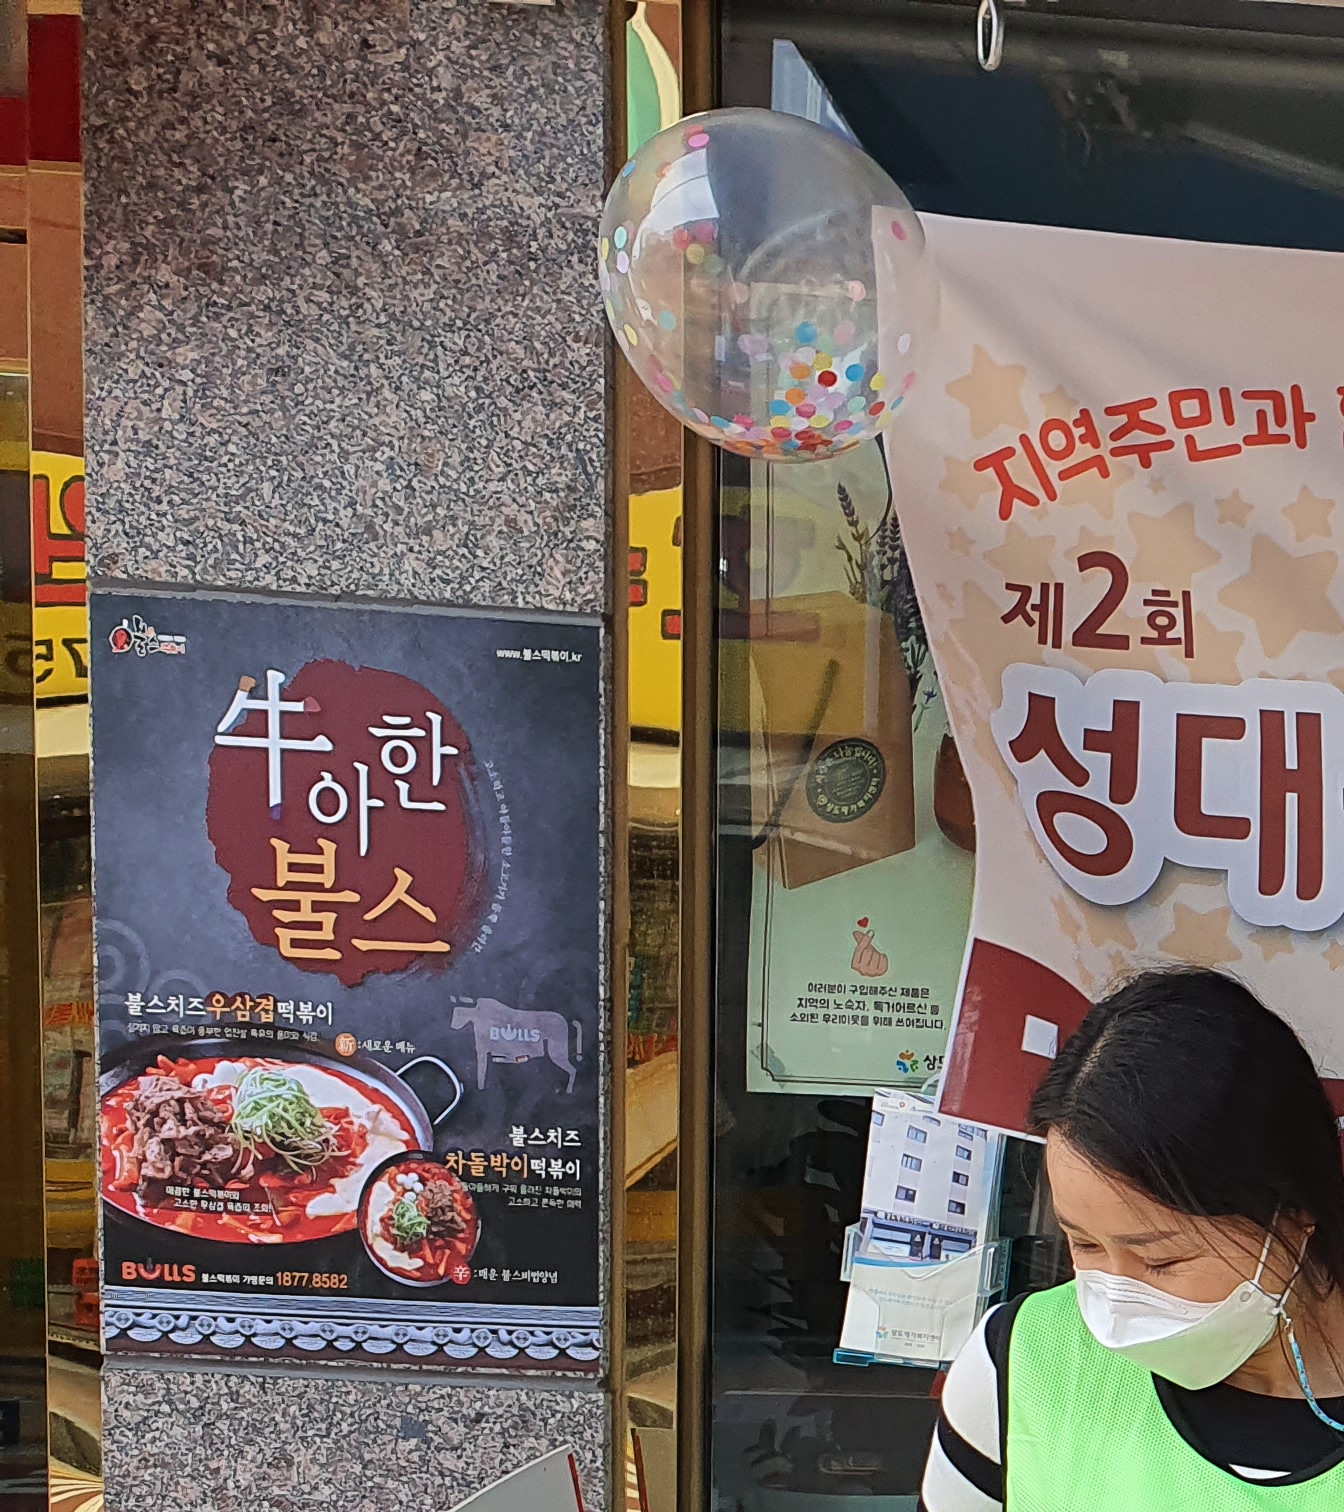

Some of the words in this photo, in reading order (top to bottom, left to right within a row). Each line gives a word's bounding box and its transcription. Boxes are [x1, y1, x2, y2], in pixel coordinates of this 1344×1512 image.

[972, 383, 1317, 522] 지역주민과
[1001, 551, 1196, 659] 제2회
[252, 836, 450, 962] 불스
[797, 997, 829, 1009] 지역의
[873, 1016, 892, 1026] 위해
[509, 1125, 581, 1148] 불스치즈
[445, 1152, 581, 1180] 차돌박이떡볶이
[276, 1272, 348, 1289] 1877.8582
[502, 1269, 558, 1283] 불스비법양념
